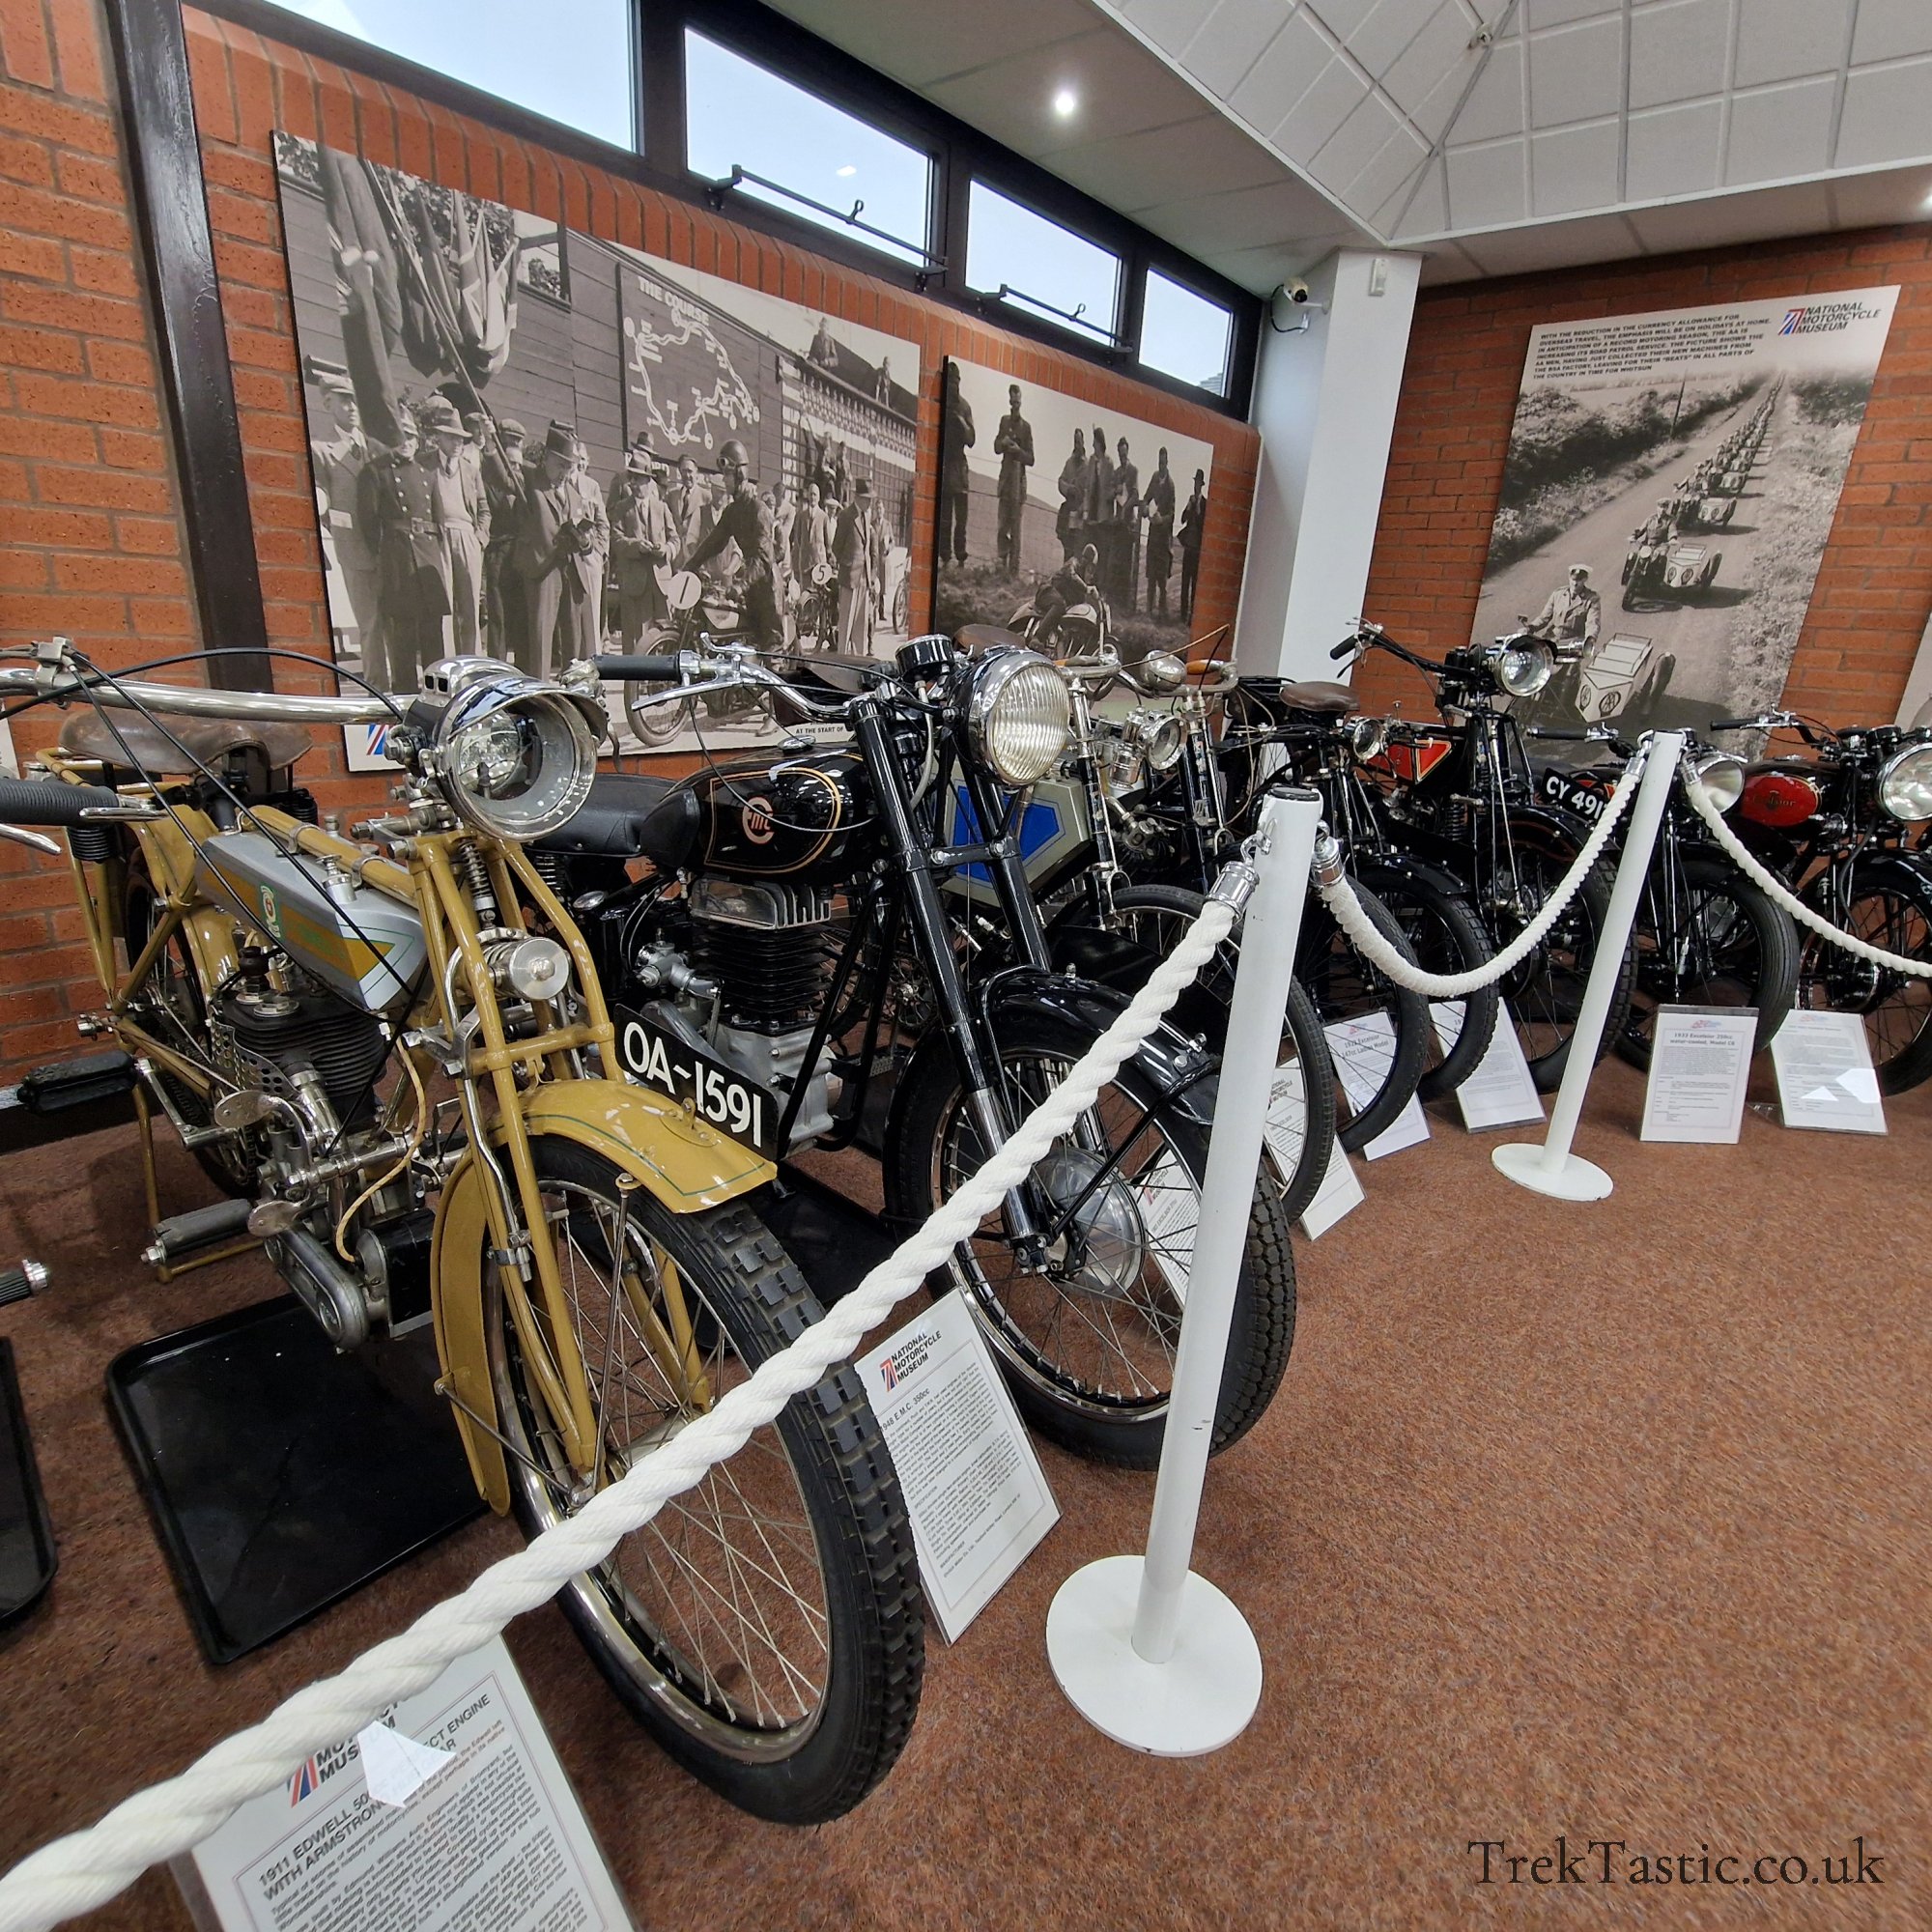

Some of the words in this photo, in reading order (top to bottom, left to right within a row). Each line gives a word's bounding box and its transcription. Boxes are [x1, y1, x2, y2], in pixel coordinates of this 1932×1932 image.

[639, 275, 663, 301] THE
[665, 291, 710, 327] COURSE
[1802, 309, 1882, 324] MOTORCYCLE
[1805, 302, 1862, 315] NATIONAL
[1638, 321, 1675, 329] CURRENCY
[1678, 316, 1722, 326] ALLOWANCE
[1796, 322, 1848, 333] MUSEUM
[1547, 777, 1571, 799] CY
[624, 1022, 761, 1148] OA-1591
[891, 1330, 927, 1363] NATIONAL
[893, 1329, 942, 1373] MOTORCYCLE
[895, 1351, 928, 1382] MUSEUM
[893, 1400, 913, 1421] E.M.C.
[912, 1385, 929, 1405] 350cc
[258, 1855, 291, 1888] 1911
[292, 1804, 353, 1861] EDWELL
[446, 1692, 491, 1734] ENGINE
[270, 1889, 299, 1916] Typical
[299, 1881, 309, 1891] of
[309, 1859, 335, 1884] scores
[336, 1850, 345, 1861] of
[345, 1818, 384, 1853] assembled
[417, 1782, 426, 1792] of
[425, 1773, 437, 1785] the
[460, 1744, 470, 1756] the
[470, 1727, 491, 1747] Edwell
[491, 1718, 501, 1730] left
[272, 1905, 292, 1924] little
[293, 1887, 314, 1908] trace
[315, 1877, 326, 1889] on
[326, 1865, 339, 1880] the
[340, 1842, 367, 1869] history
[367, 1834, 376, 1845] of
[420, 1777, 443, 1801] except
[443, 1755, 470, 1781] perhaps
[476, 1741, 486, 1752] its
[486, 1724, 505, 1745] native
[310, 1903, 329, 1922] built
[330, 1892, 342, 1906] by
[343, 1863, 375, 1893] Edmund
[376, 1836, 407, 1864] Williams
[408, 1820, 425, 1837] Auto
[425, 1791, 460, 1823] Engineers
[501, 1744, 513, 1755] but
[262, 1862, 303, 1902] WITH
[497, 1869, 513, 1886] JAP
[511, 1858, 525, 1873] and
[488, 1889, 515, 1916] London
[515, 1875, 528, 1889] and
